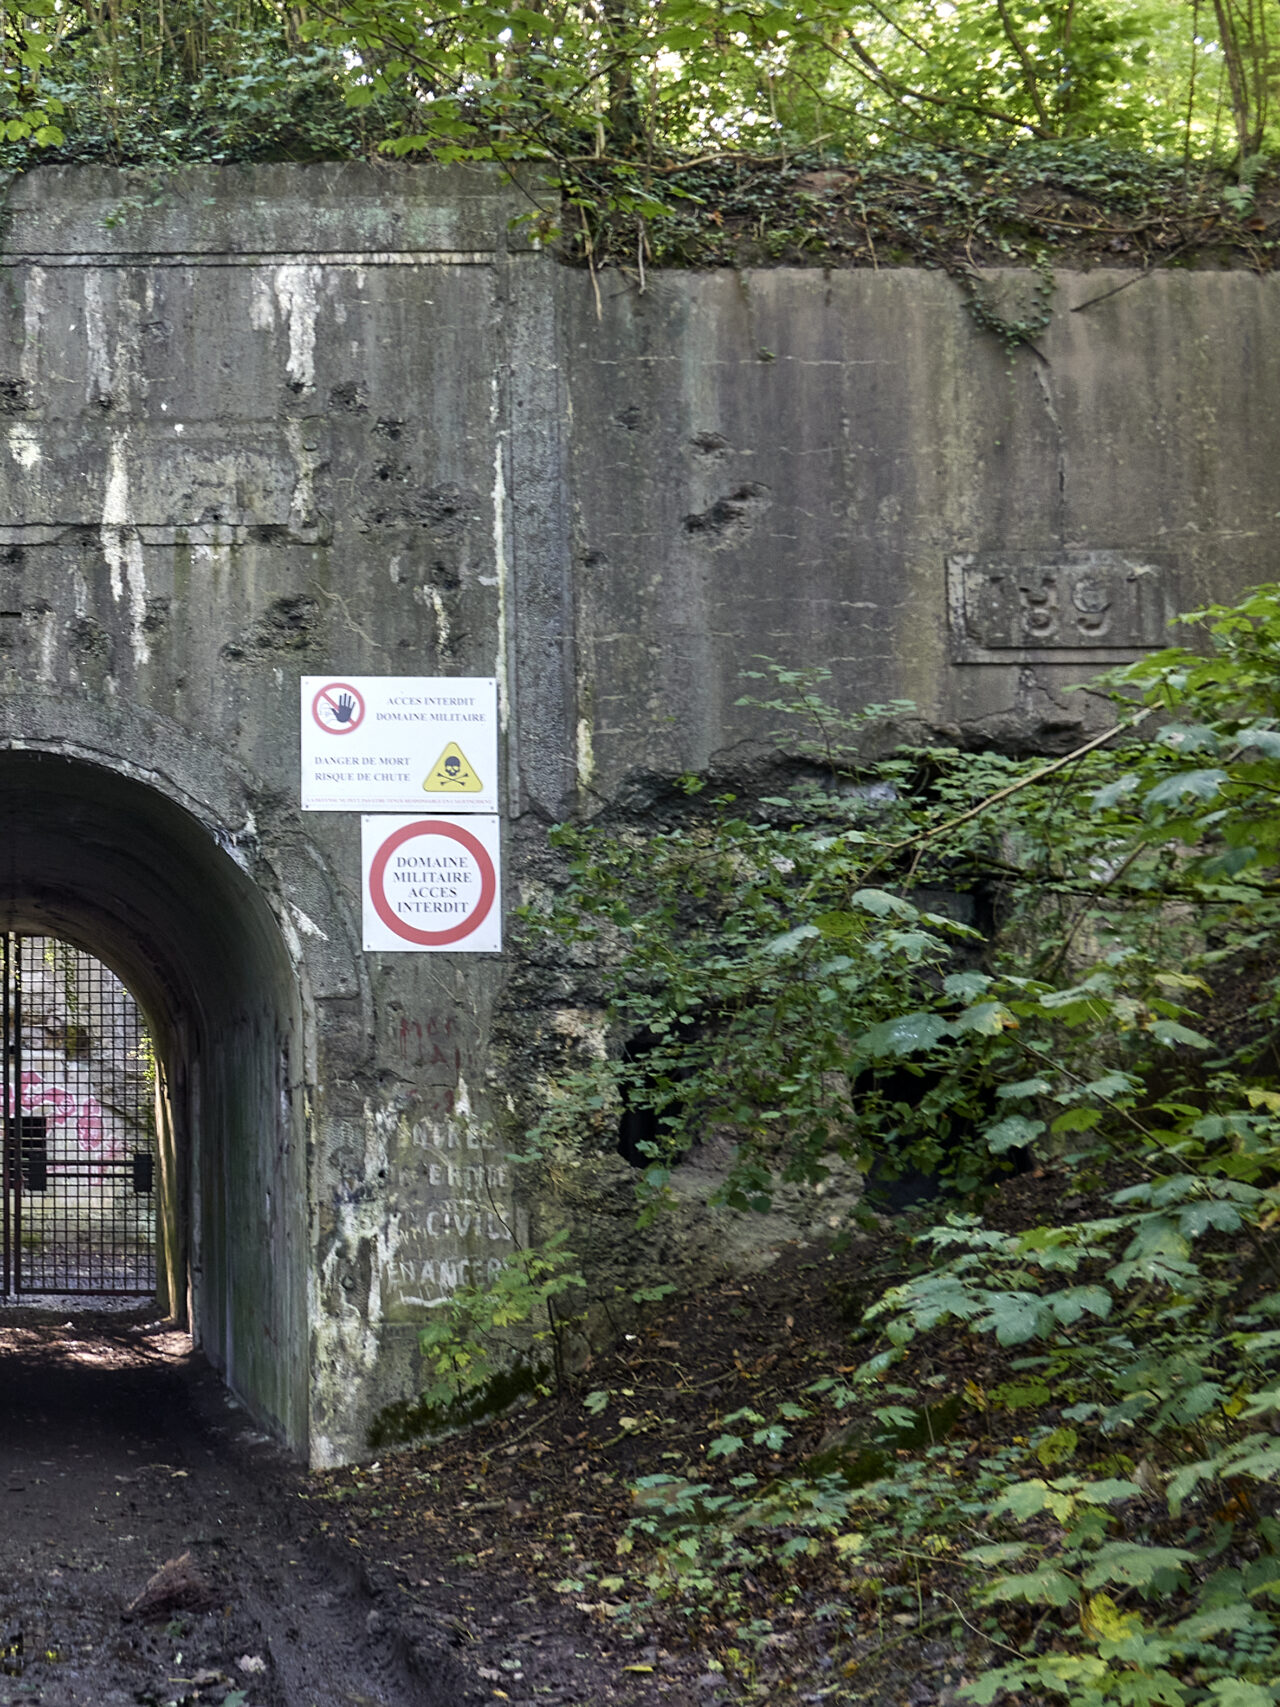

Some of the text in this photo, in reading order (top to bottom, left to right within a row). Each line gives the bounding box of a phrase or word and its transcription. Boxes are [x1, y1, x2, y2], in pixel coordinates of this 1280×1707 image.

[386, 697, 476, 707] ACCES INTERDIT
[376, 712, 487, 723] DOMAINE MILITAIRE
[314, 756, 410, 766] DANGER DE MORT
[314, 772, 411, 783] RISQUE DE CHUTE
[396, 856, 469, 868] DOMAINE
[393, 871, 473, 883] MILITAIRE
[407, 887, 458, 899] ACCES
[397, 901, 469, 913] INTERDIT
